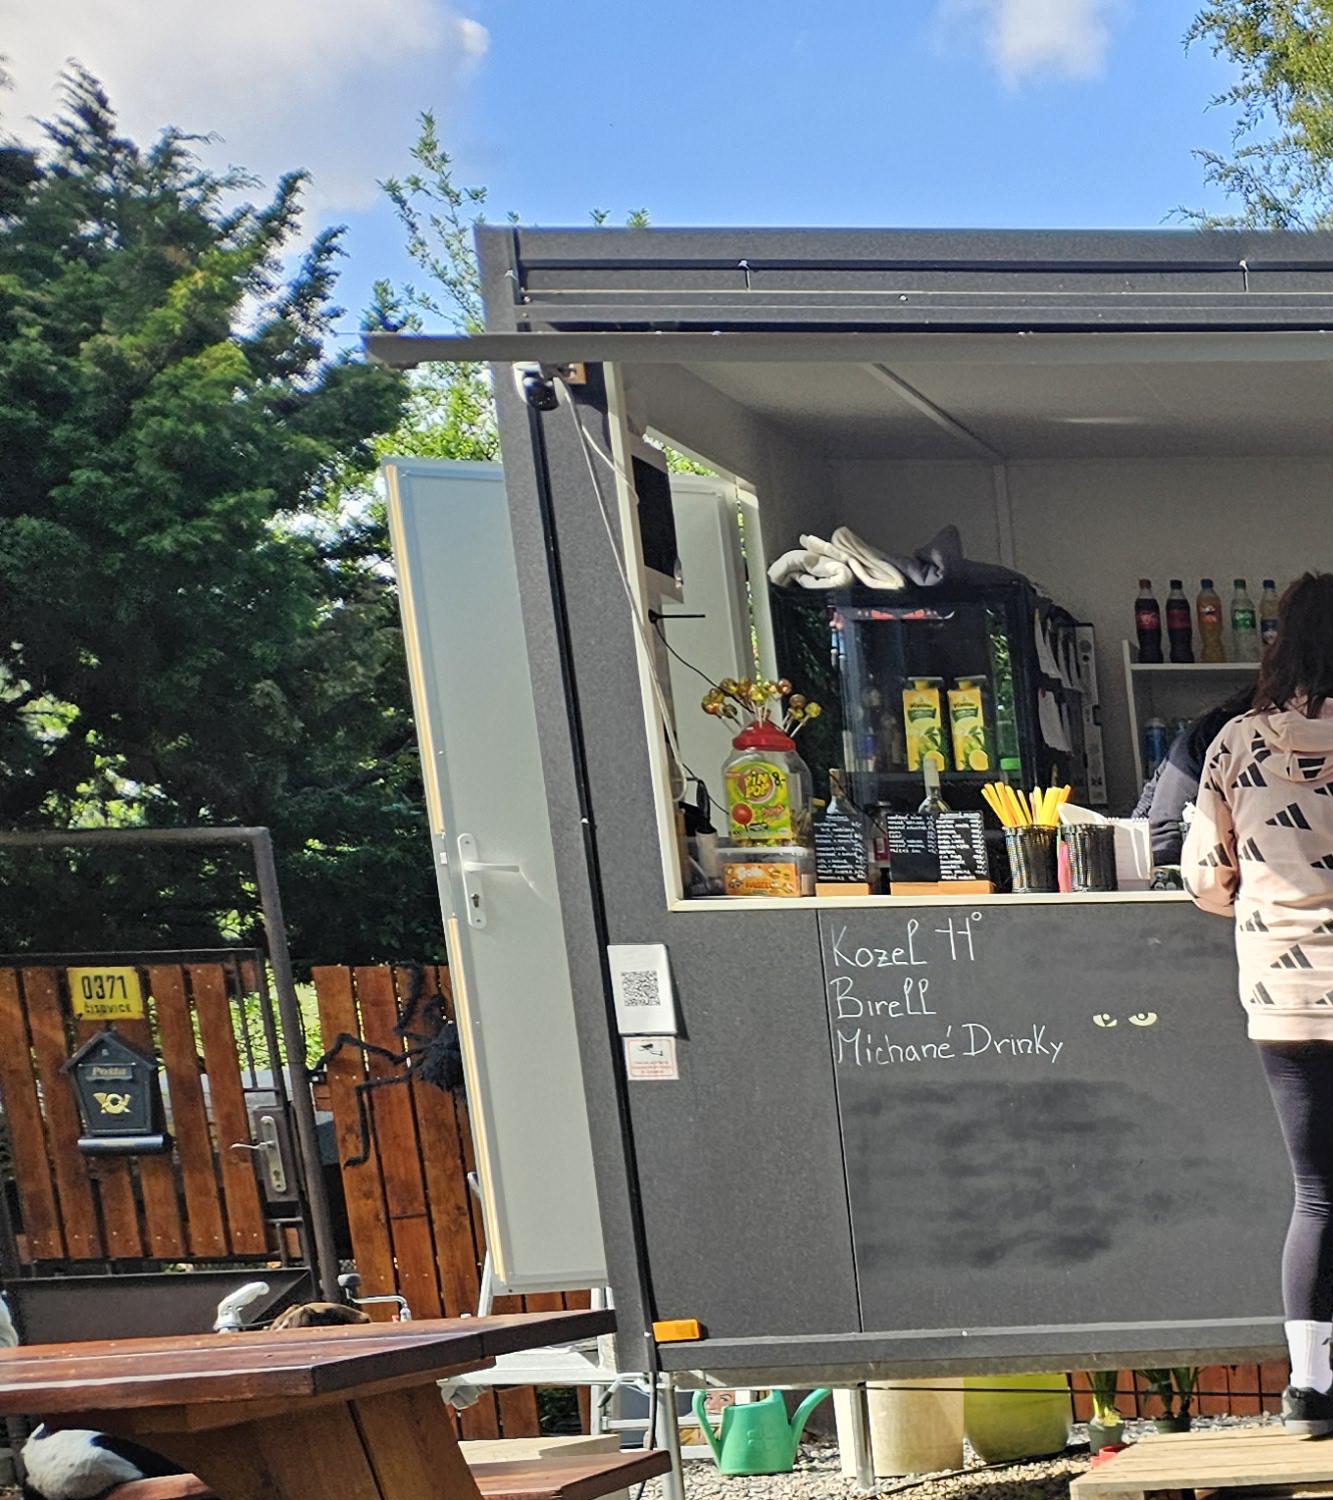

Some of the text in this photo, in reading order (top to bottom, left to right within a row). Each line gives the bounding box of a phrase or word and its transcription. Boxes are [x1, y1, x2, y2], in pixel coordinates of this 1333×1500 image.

[832, 919, 927, 967] Kozel
[81, 975, 128, 1000] 0371
[830, 976, 937, 1019] Birell
[961, 1023, 1064, 1064] Drinky
